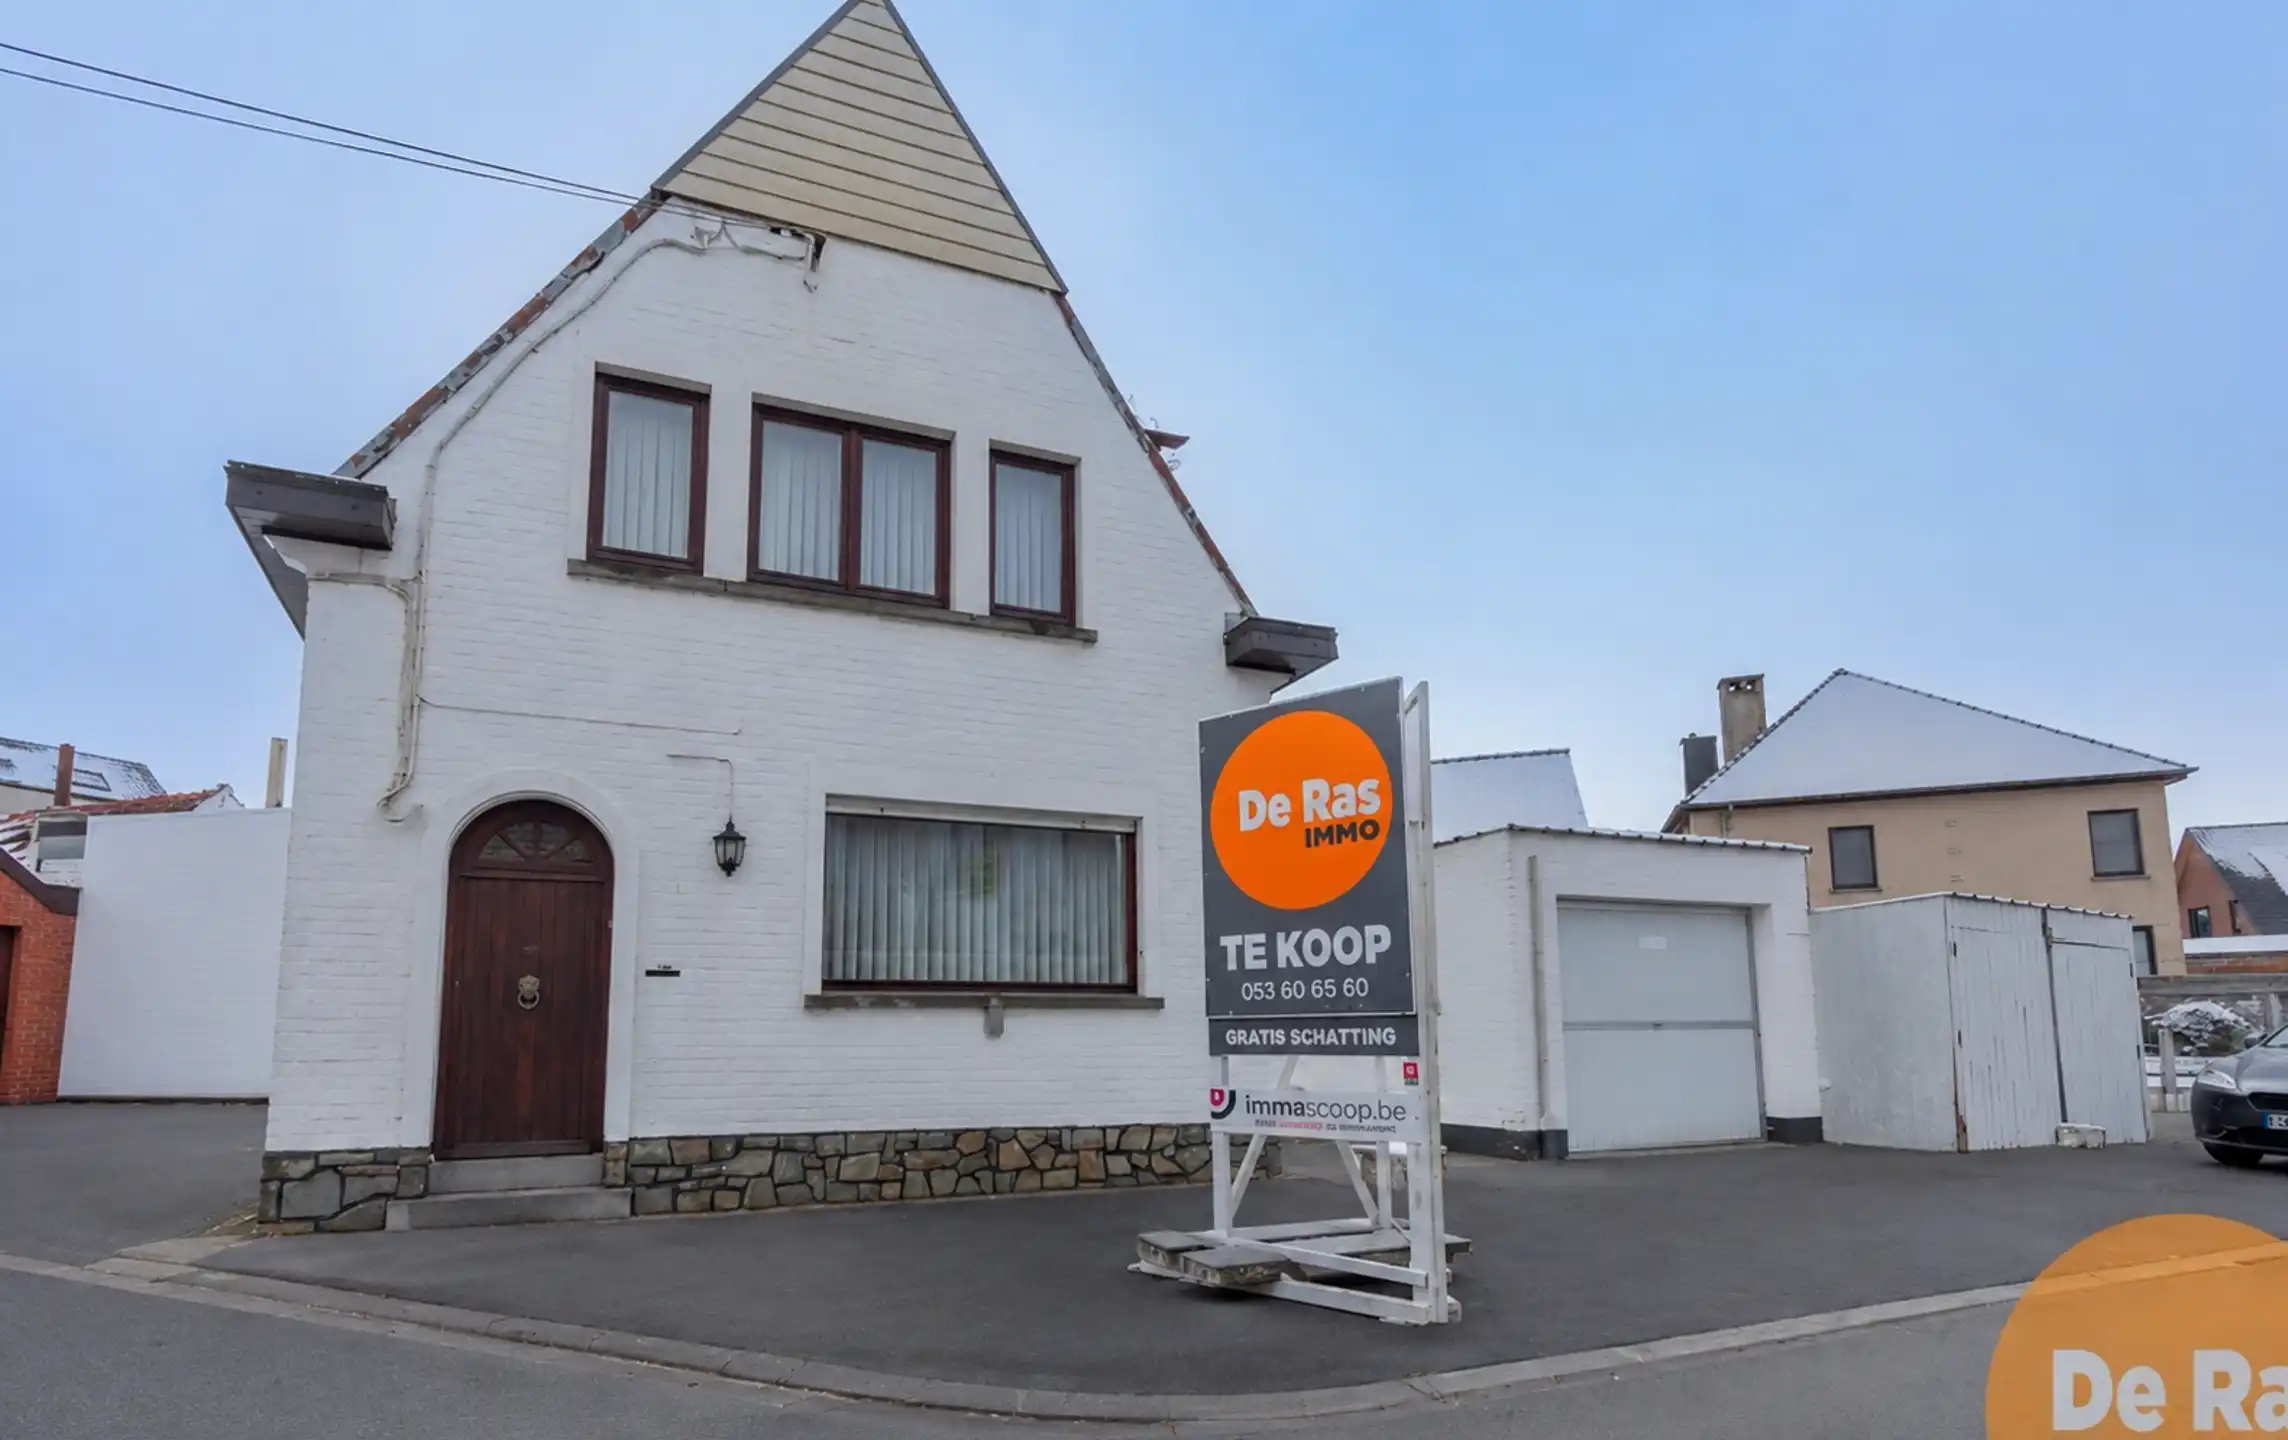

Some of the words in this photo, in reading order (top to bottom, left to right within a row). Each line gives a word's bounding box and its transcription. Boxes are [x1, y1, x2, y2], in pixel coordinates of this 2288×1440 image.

[1238, 789, 1291, 831] De
[1302, 778, 1380, 823] Ras
[1305, 819, 1380, 848] IMMO
[1220, 933, 1267, 971] TE
[1276, 924, 1391, 968] KOOP
[1241, 981, 1275, 1001] 053
[1281, 980, 1305, 999] 60
[1311, 979, 1336, 998] 65
[1343, 977, 1369, 997] 60
[1225, 1028, 1286, 1046] GRATIS
[1291, 1027, 1397, 1046] SCHATTING
[1245, 1094, 1406, 1123] immascoop.be
